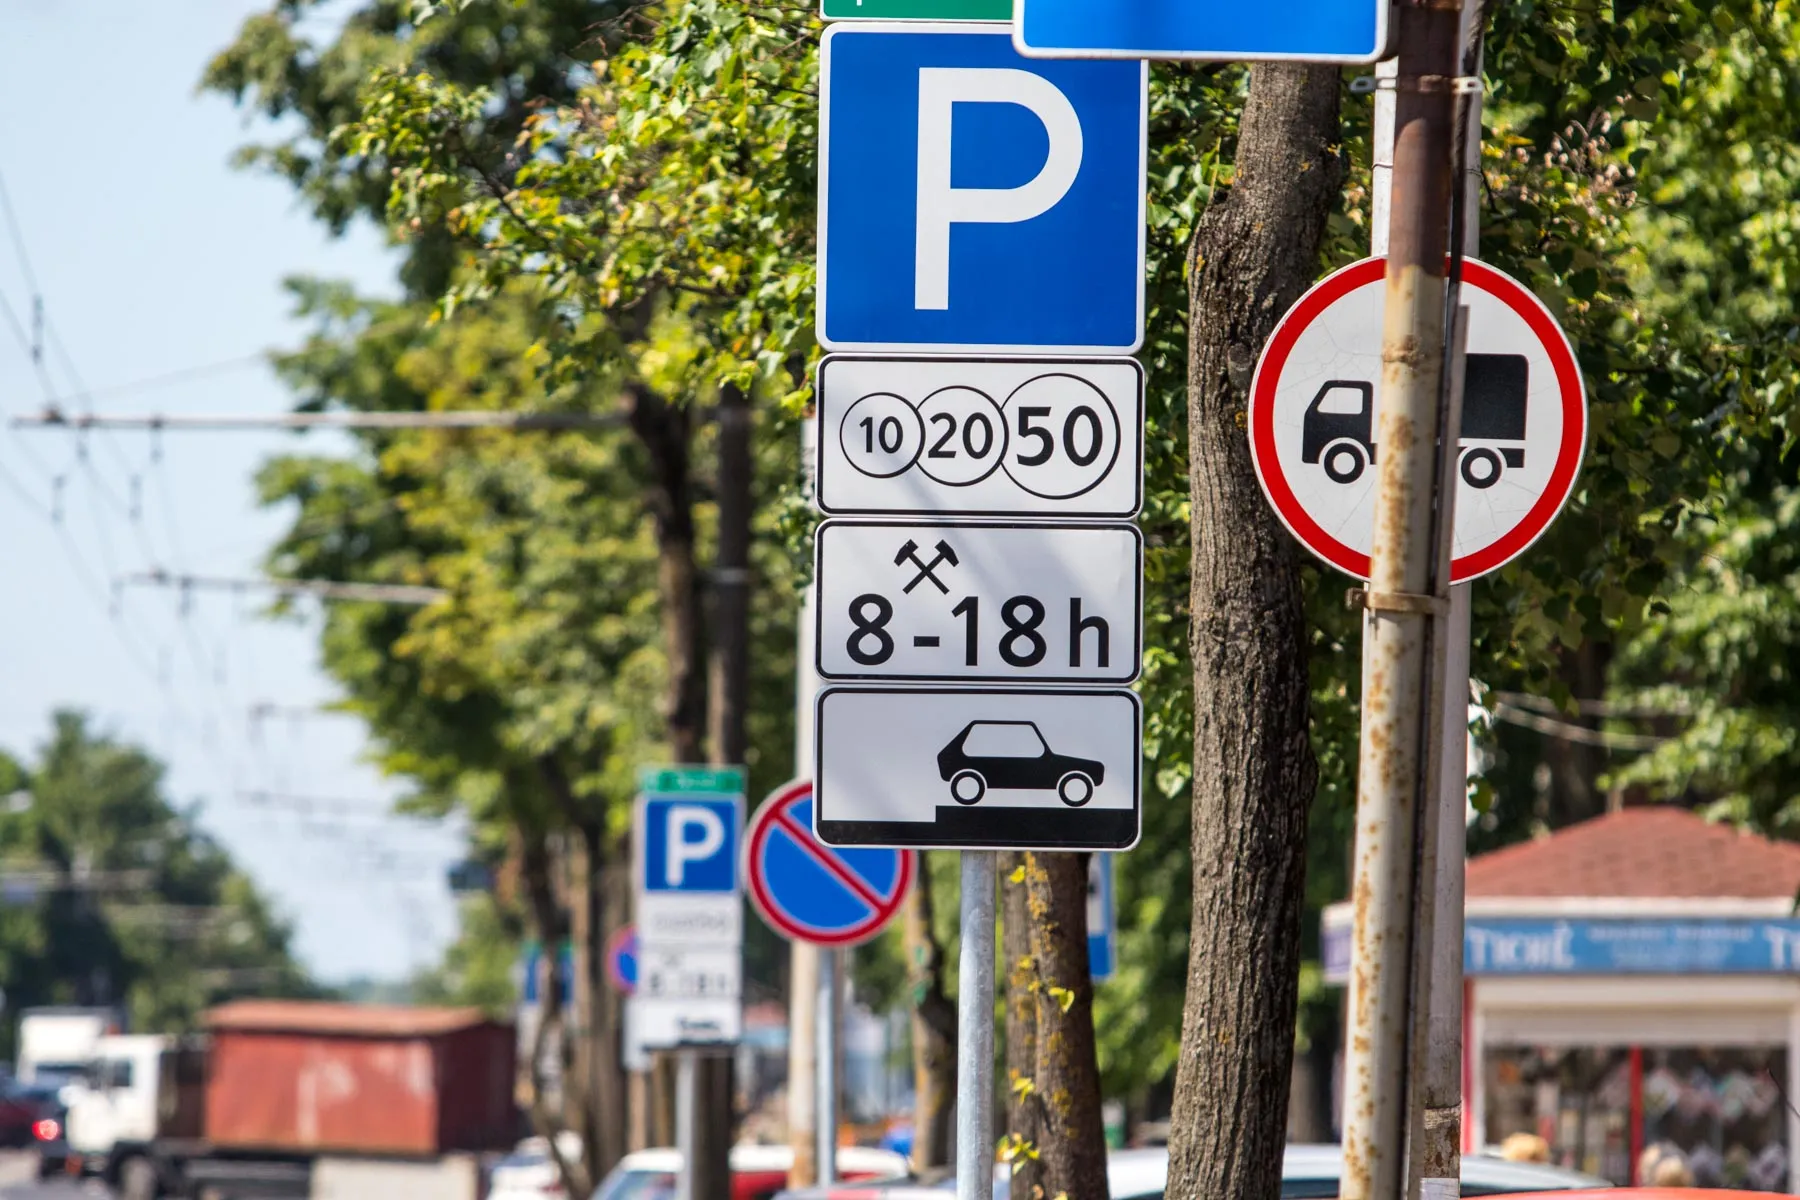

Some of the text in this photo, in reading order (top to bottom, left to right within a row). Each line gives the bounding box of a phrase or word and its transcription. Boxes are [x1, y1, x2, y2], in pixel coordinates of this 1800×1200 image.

[915, 67, 1083, 310] P
[859, 406, 1103, 466] 10 20 50
[665, 805, 724, 886] P
